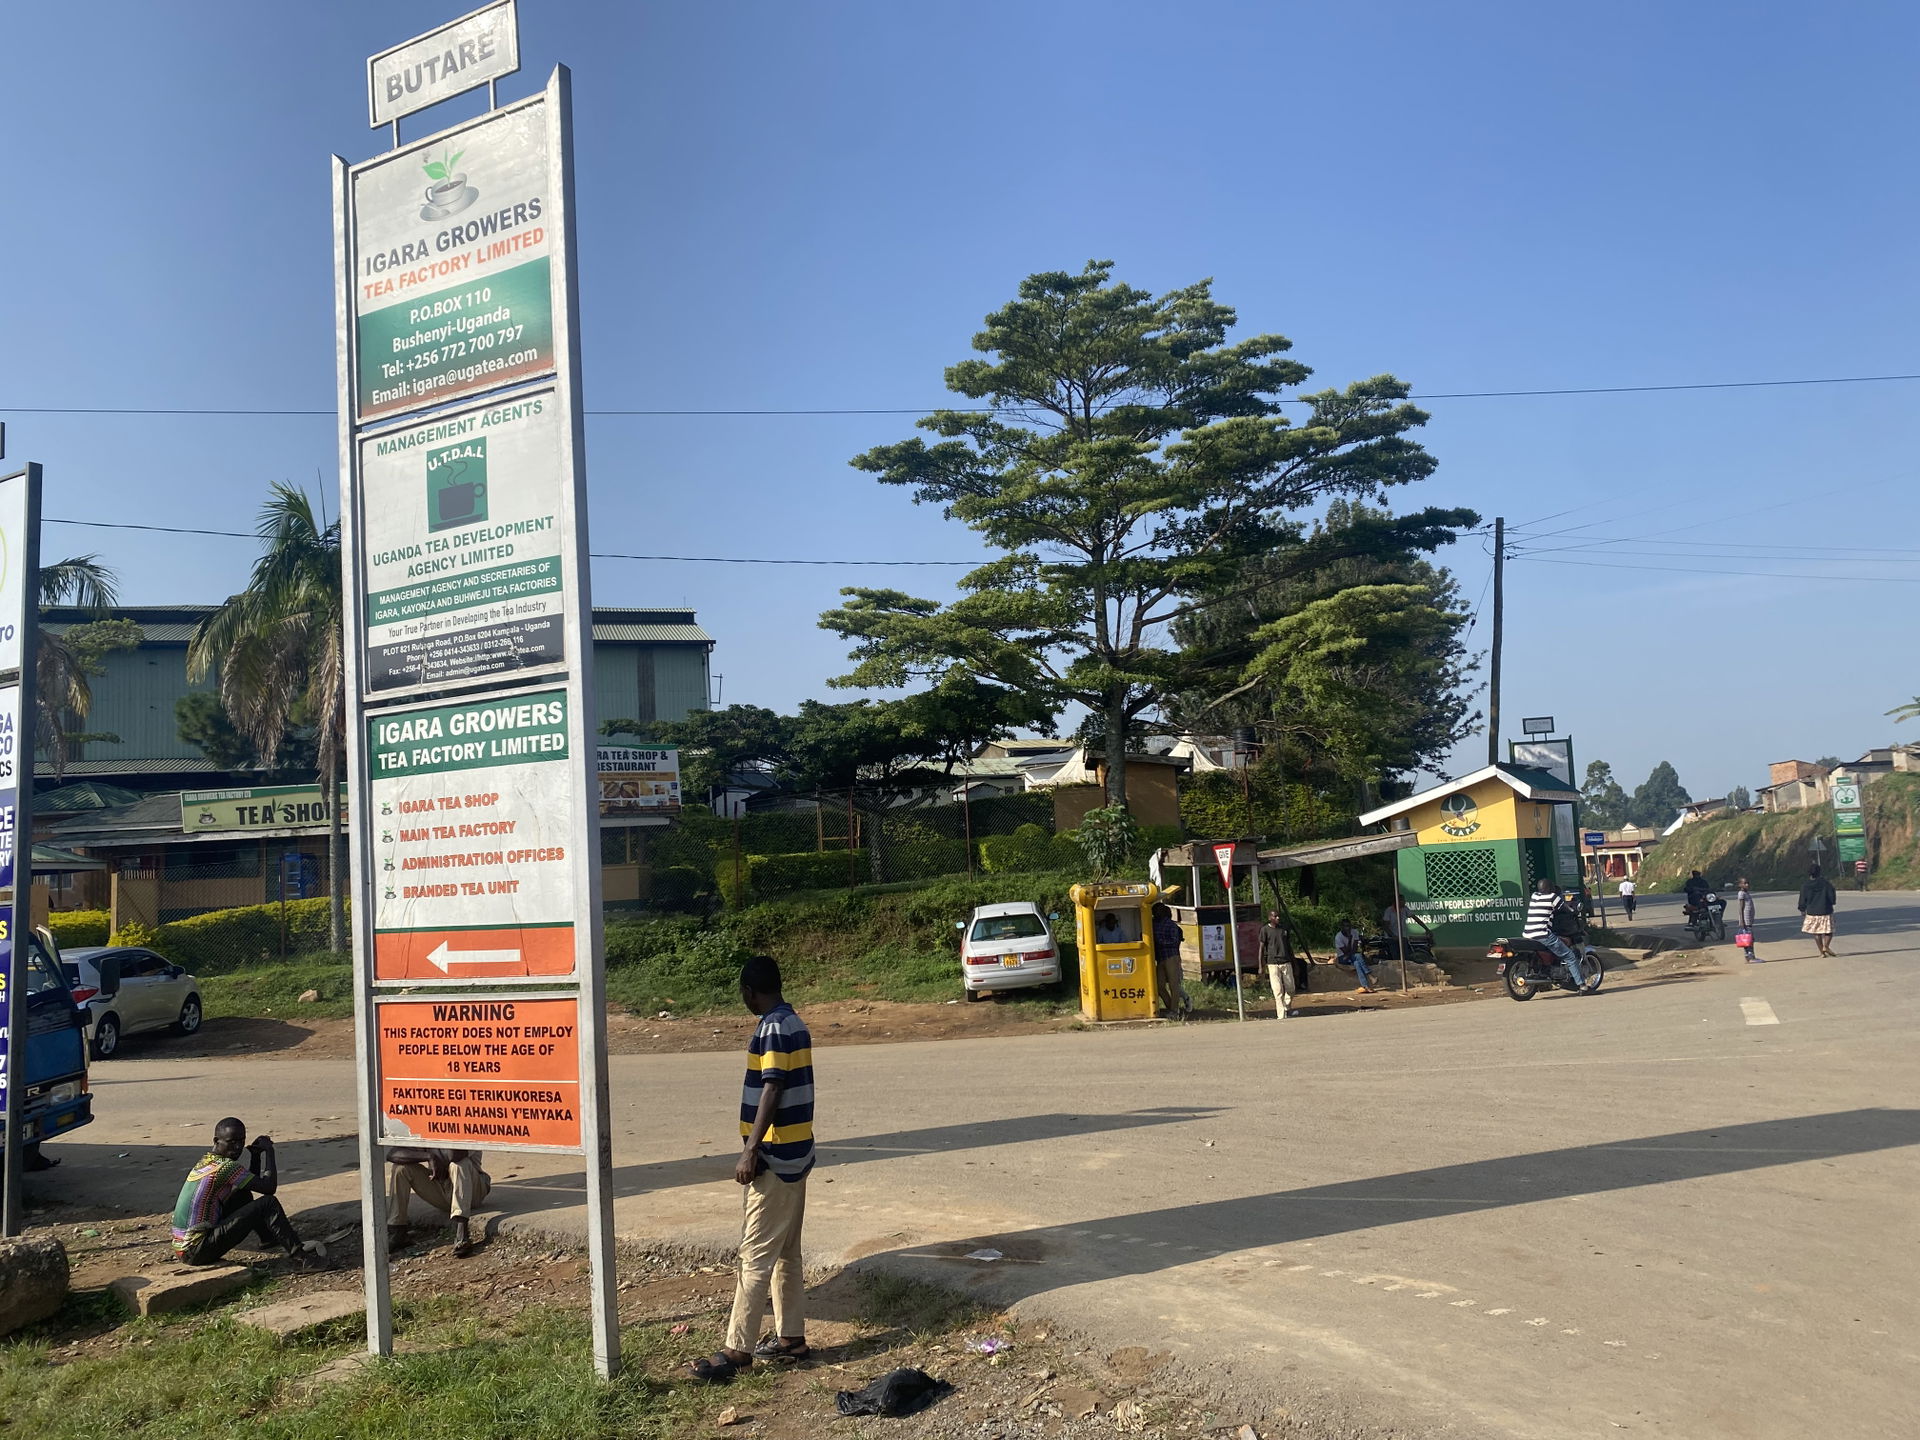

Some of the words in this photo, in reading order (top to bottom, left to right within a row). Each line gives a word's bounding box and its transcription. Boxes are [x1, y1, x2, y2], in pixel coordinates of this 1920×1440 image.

[386, 30, 495, 102] BUTARE
[366, 238, 430, 276] IGARA
[436, 197, 542, 252] GROWERS
[363, 276, 394, 300] TEA
[399, 255, 470, 291] FACTORY
[476, 227, 544, 265] LIMITED
[410, 294, 462, 324] P.O.BOX
[465, 288, 491, 310] 110
[392, 306, 511, 354] Bushenyi-Uganda
[382, 360, 404, 380] Tel:
[406, 349, 438, 373] +256
[442, 340, 466, 364] 772
[469, 332, 494, 355] 700
[497, 324, 524, 348] 797
[372, 383, 410, 406] Email:
[412, 346, 538, 396] igara@ugatea.com
[377, 417, 476, 456] MANAGEMENT
[480, 399, 543, 428] AGENTS
[428, 445, 484, 471] U.T.D.A.L
[372, 544, 422, 567] UGANDA
[426, 538, 450, 554] TEA
[453, 516, 554, 548] DEVELOPMENT
[407, 556, 456, 579] AGENCY
[461, 544, 514, 566] LIMITED
[375, 608, 400, 620] IGARA,
[401, 600, 436, 616] KAYONZA
[436, 596, 453, 608] AND
[454, 588, 491, 604] BUHWEJU
[492, 586, 508, 597] TEA
[510, 576, 558, 594] FACTORIES
[380, 586, 430, 605] MANAGEMENT
[431, 579, 462, 594] AGENCY
[462, 576, 479, 588] AND
[480, 564, 536, 584] SECRETARIES
[538, 562, 551, 573] OF
[388, 628, 403, 638] Your
[404, 625, 418, 635] True
[420, 620, 444, 632] Partner
[445, 618, 452, 628] in
[452, 611, 488, 626] Developing
[490, 608, 500, 618] the
[502, 606, 514, 616] Tea
[516, 602, 547, 614] Industry
[383, 646, 400, 656] PLOT
[524, 620, 551, 632] Uganda
[379, 716, 444, 746] IGARA
[450, 700, 564, 736] GROWERS
[378, 752, 408, 770] TEA
[412, 742, 486, 766] FACTORY
[490, 732, 564, 758] LIMITED
[611, 751, 629, 760] TEA
[632, 750, 658, 760] SHOP
[661, 750, 668, 760] &
[236, 804, 275, 825] TEA
[399, 798, 435, 814] IGARA
[437, 796, 462, 811] TEA
[464, 792, 500, 808] SHOP
[400, 827, 430, 842] MAIN
[432, 825, 456, 840] TEA
[459, 820, 516, 838] FACTORY
[401, 850, 504, 870] ADMINISTRATION
[507, 847, 565, 864] OFFICES
[403, 883, 458, 898] BRANDED
[461, 881, 486, 896] TEA
[488, 880, 520, 894] UNIT
[1433, 914, 1447, 923] AND
[1448, 913, 1473, 923] CREDIT
[1475, 912, 1505, 922] SOCIETY
[1507, 912, 1522, 920] LTD.
[432, 1004, 515, 1022] WARNING
[384, 1028, 407, 1038] THIS
[410, 1026, 459, 1038] FACTORY
[462, 1026, 492, 1038] DOES
[496, 1026, 520, 1038] NOT
[524, 1026, 573, 1038] EMPLOY
[398, 1044, 439, 1055] PEOPLE
[442, 1044, 481, 1055] BELOW
[484, 1044, 507, 1055] THE
[511, 1044, 535, 1056] AGE
[538, 1044, 554, 1056] OF
[447, 1061, 460, 1072] 18
[464, 1061, 501, 1072] YEARS
[393, 1088, 445, 1100] FAKITORE
[448, 1089, 467, 1100] EGI
[470, 1090, 562, 1103] TERIKUKORESA
[435, 1105, 461, 1117] BARI
[464, 1106, 508, 1119] AHANSI
[511, 1108, 573, 1121] Y'EMYAKA
[428, 1122, 460, 1134] IKUMI
[464, 1123, 530, 1137] NAMUNANA
